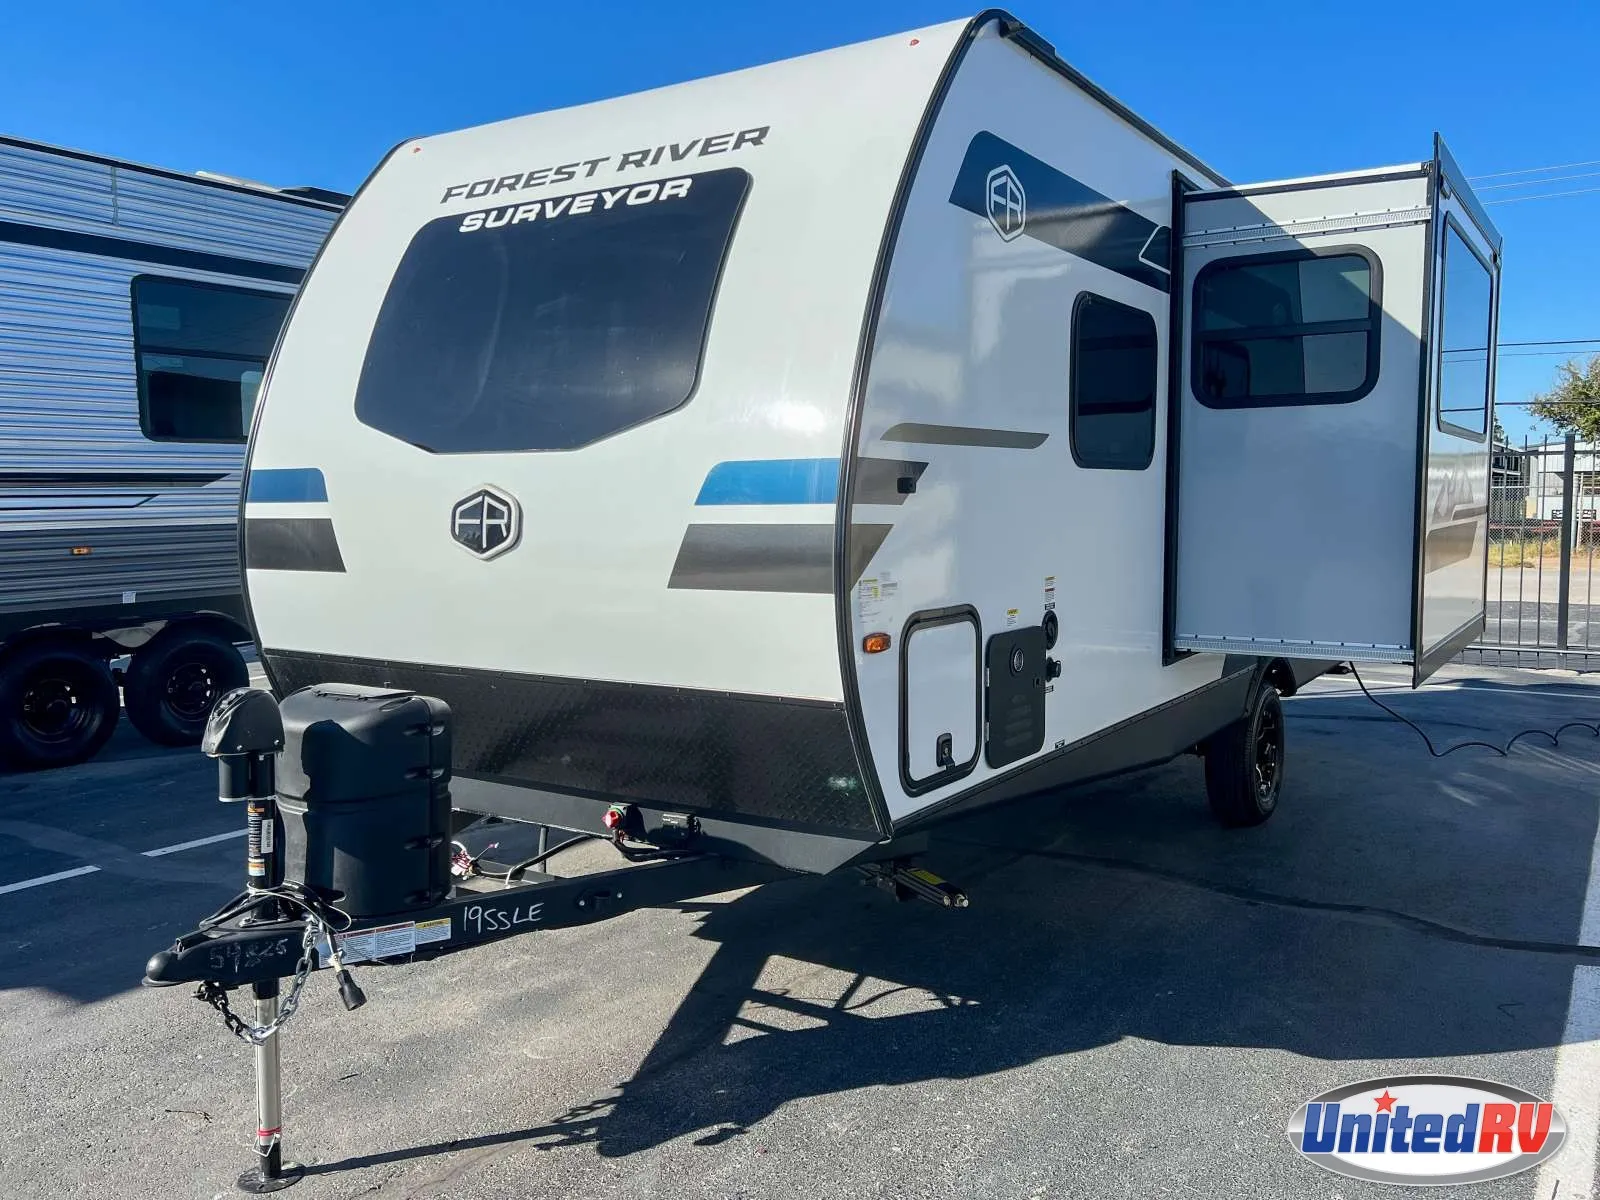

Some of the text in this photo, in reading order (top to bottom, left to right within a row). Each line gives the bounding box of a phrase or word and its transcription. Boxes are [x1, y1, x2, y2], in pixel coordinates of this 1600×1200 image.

[440, 126, 771, 204] FOREST RIVER
[459, 178, 693, 233] SURVEYOR
